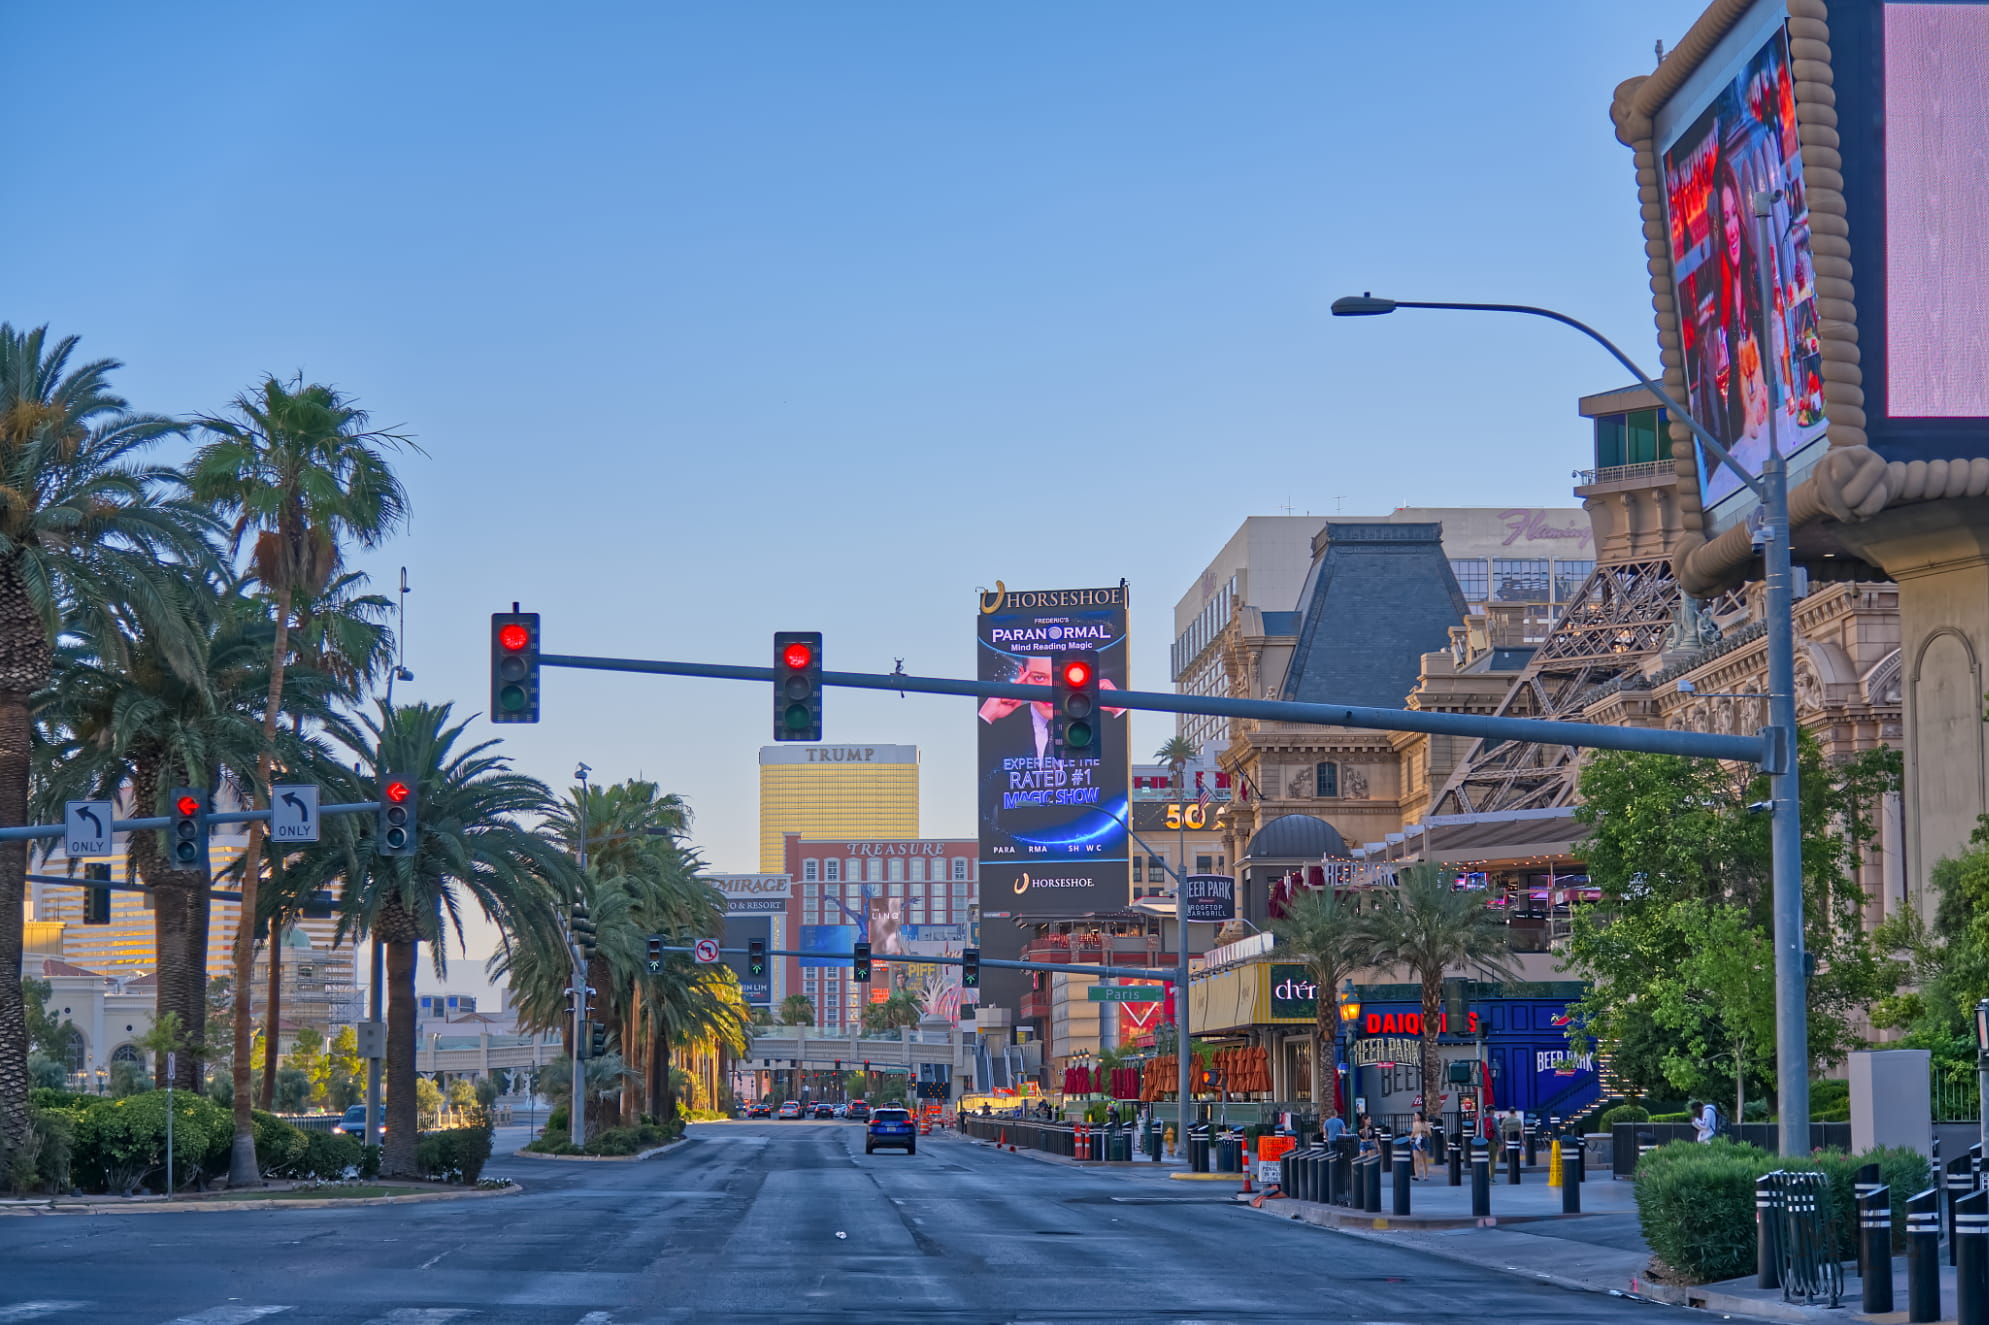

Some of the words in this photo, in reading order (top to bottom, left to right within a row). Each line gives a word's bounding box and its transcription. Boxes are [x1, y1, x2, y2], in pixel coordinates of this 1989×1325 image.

[992, 625, 1111, 643] PARANORMAL
[1011, 644, 1030, 652] Mind
[1033, 642, 1066, 652] Reading
[1069, 641, 1093, 651] Magic
[806, 748, 875, 762] TRUMP
[1009, 770, 1068, 790] RATED
[1072, 768, 1091, 786] #1
[1004, 790, 1054, 809] MAGIC
[1056, 786, 1100, 804] SHOW
[278, 826, 311, 836] ONLY
[72, 842, 104, 852] ONLY
[847, 843, 945, 856] TREASURE
[1324, 862, 1359, 887] BEER
[718, 878, 787, 894] MIRAGE
[1032, 878, 1094, 888] HORSESHOE
[1186, 881, 1206, 898] EER
[1208, 881, 1231, 900] PARK
[747, 902, 781, 910] RESORT
[872, 912, 898, 920] LINQ
[908, 962, 936, 977] PIFF
[1106, 988, 1140, 1000] Paris
[1354, 1038, 1384, 1066] BEER
[1387, 1038, 1420, 1068] PARK
[1536, 1050, 1564, 1072] BEER
